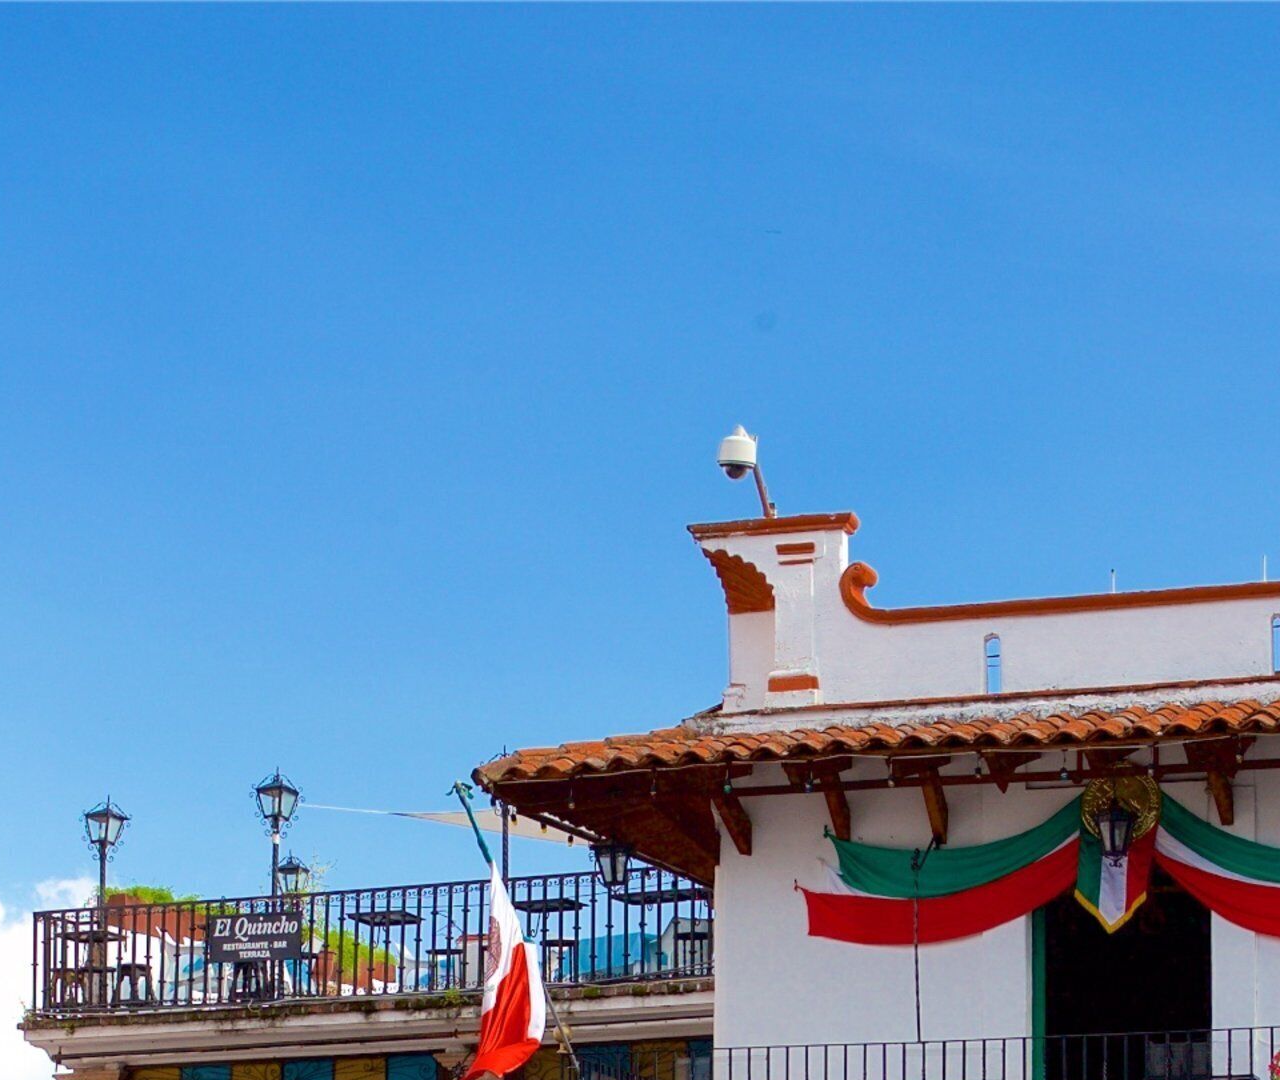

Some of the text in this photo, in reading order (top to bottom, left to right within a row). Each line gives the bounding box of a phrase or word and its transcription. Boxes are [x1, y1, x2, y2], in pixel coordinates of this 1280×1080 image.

[213, 915, 298, 942] El Quincho
[239, 950, 271, 959] TERRAZA
